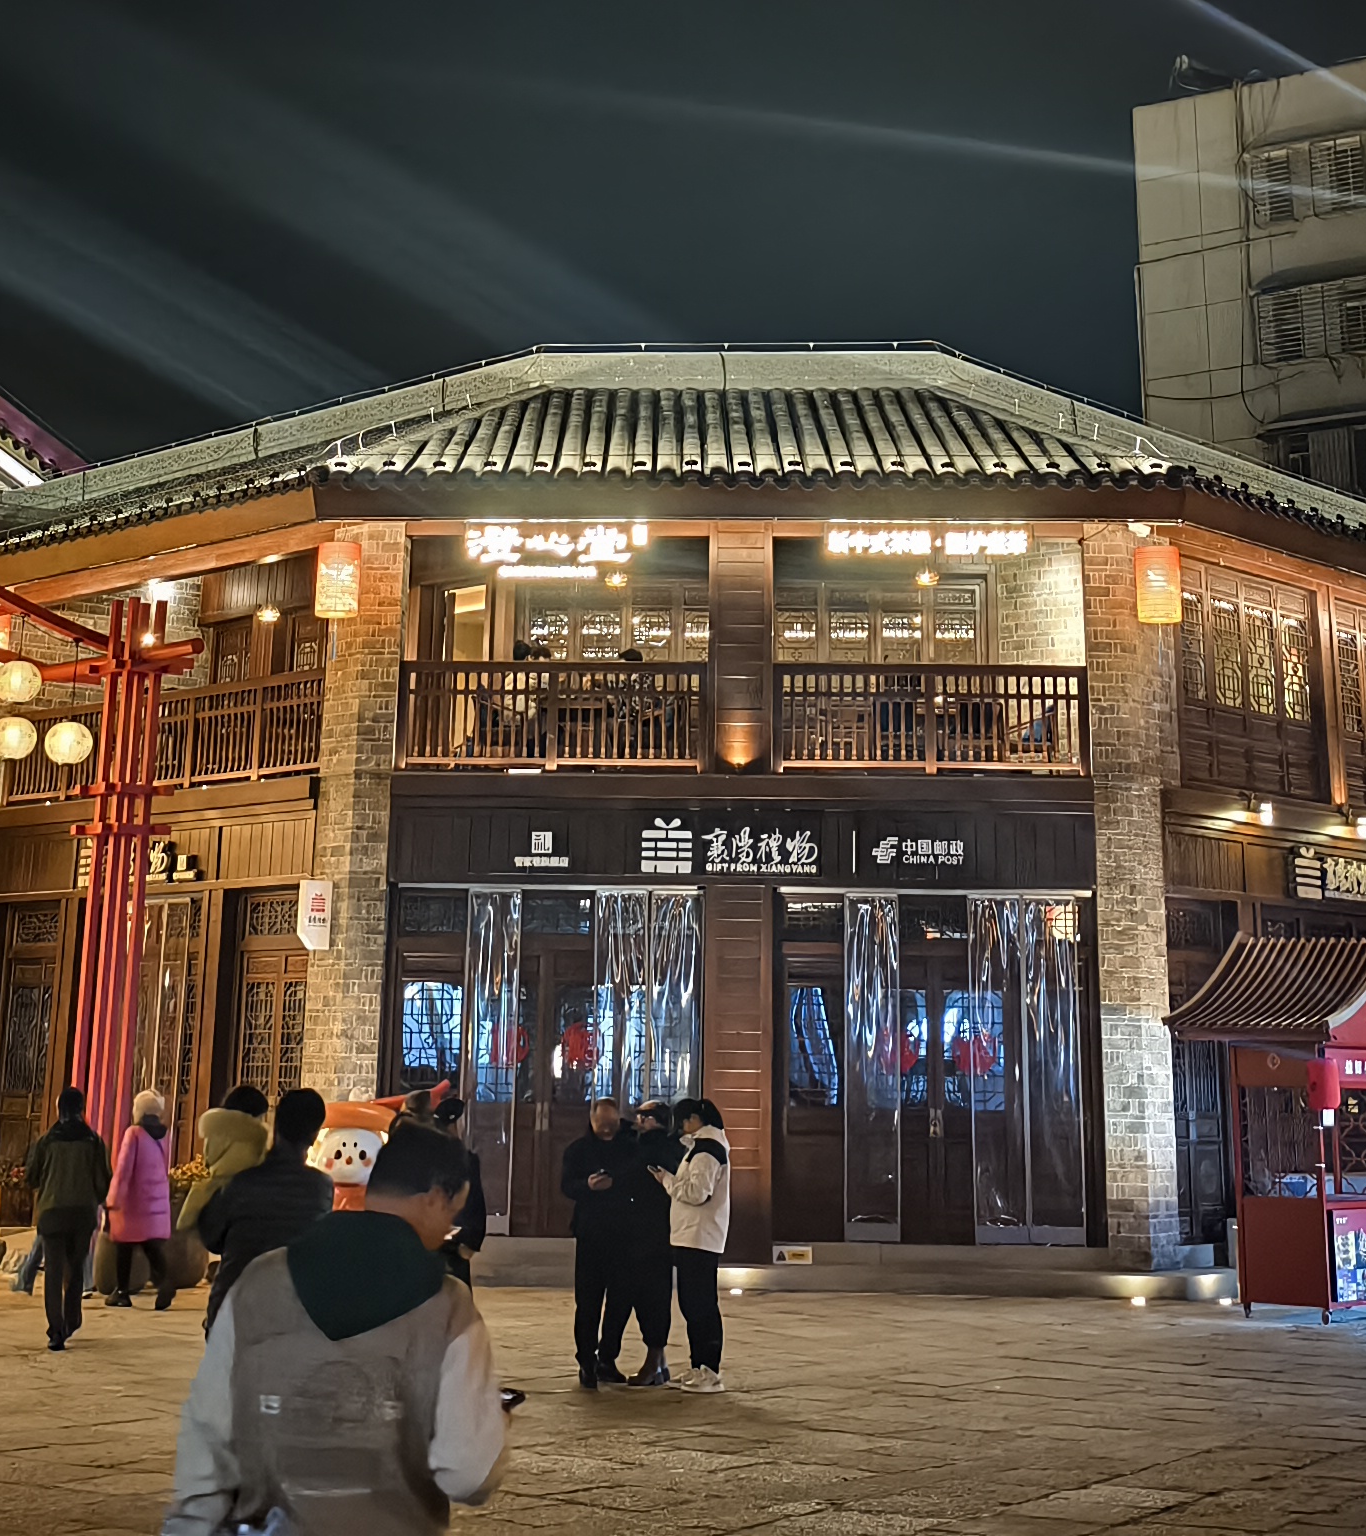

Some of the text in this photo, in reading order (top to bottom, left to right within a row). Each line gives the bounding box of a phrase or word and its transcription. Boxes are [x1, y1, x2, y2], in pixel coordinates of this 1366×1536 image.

[902, 839, 964, 855] 中国邮政
[903, 855, 964, 865] CHINA POST
[705, 862, 816, 873] GIFT FROM XIANGYANG
